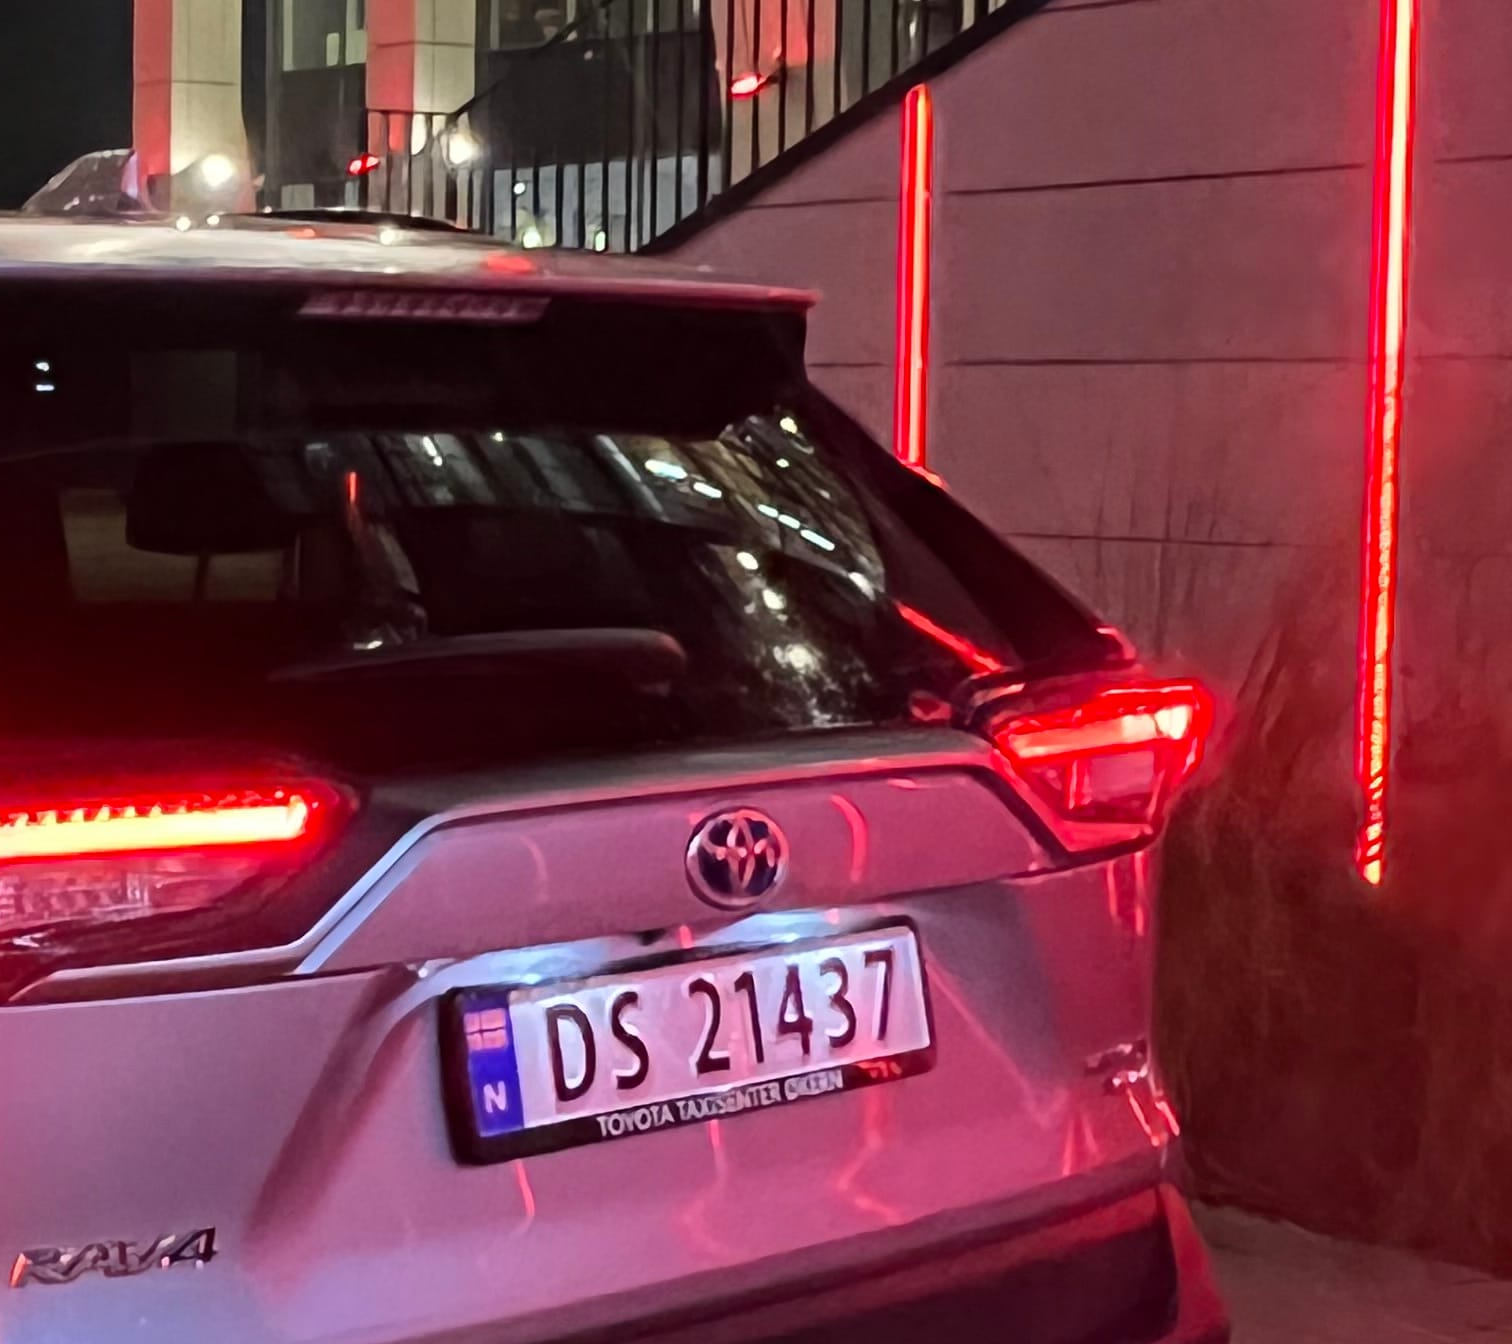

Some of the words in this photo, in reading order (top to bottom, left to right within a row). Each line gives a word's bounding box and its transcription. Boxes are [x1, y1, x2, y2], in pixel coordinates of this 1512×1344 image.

[547, 991, 650, 1102] DS
[688, 947, 894, 1074] 21437
[482, 1080, 508, 1114] N
[596, 1103, 675, 1136] TOYOTA
[8, 1225, 219, 1289] RAV4
